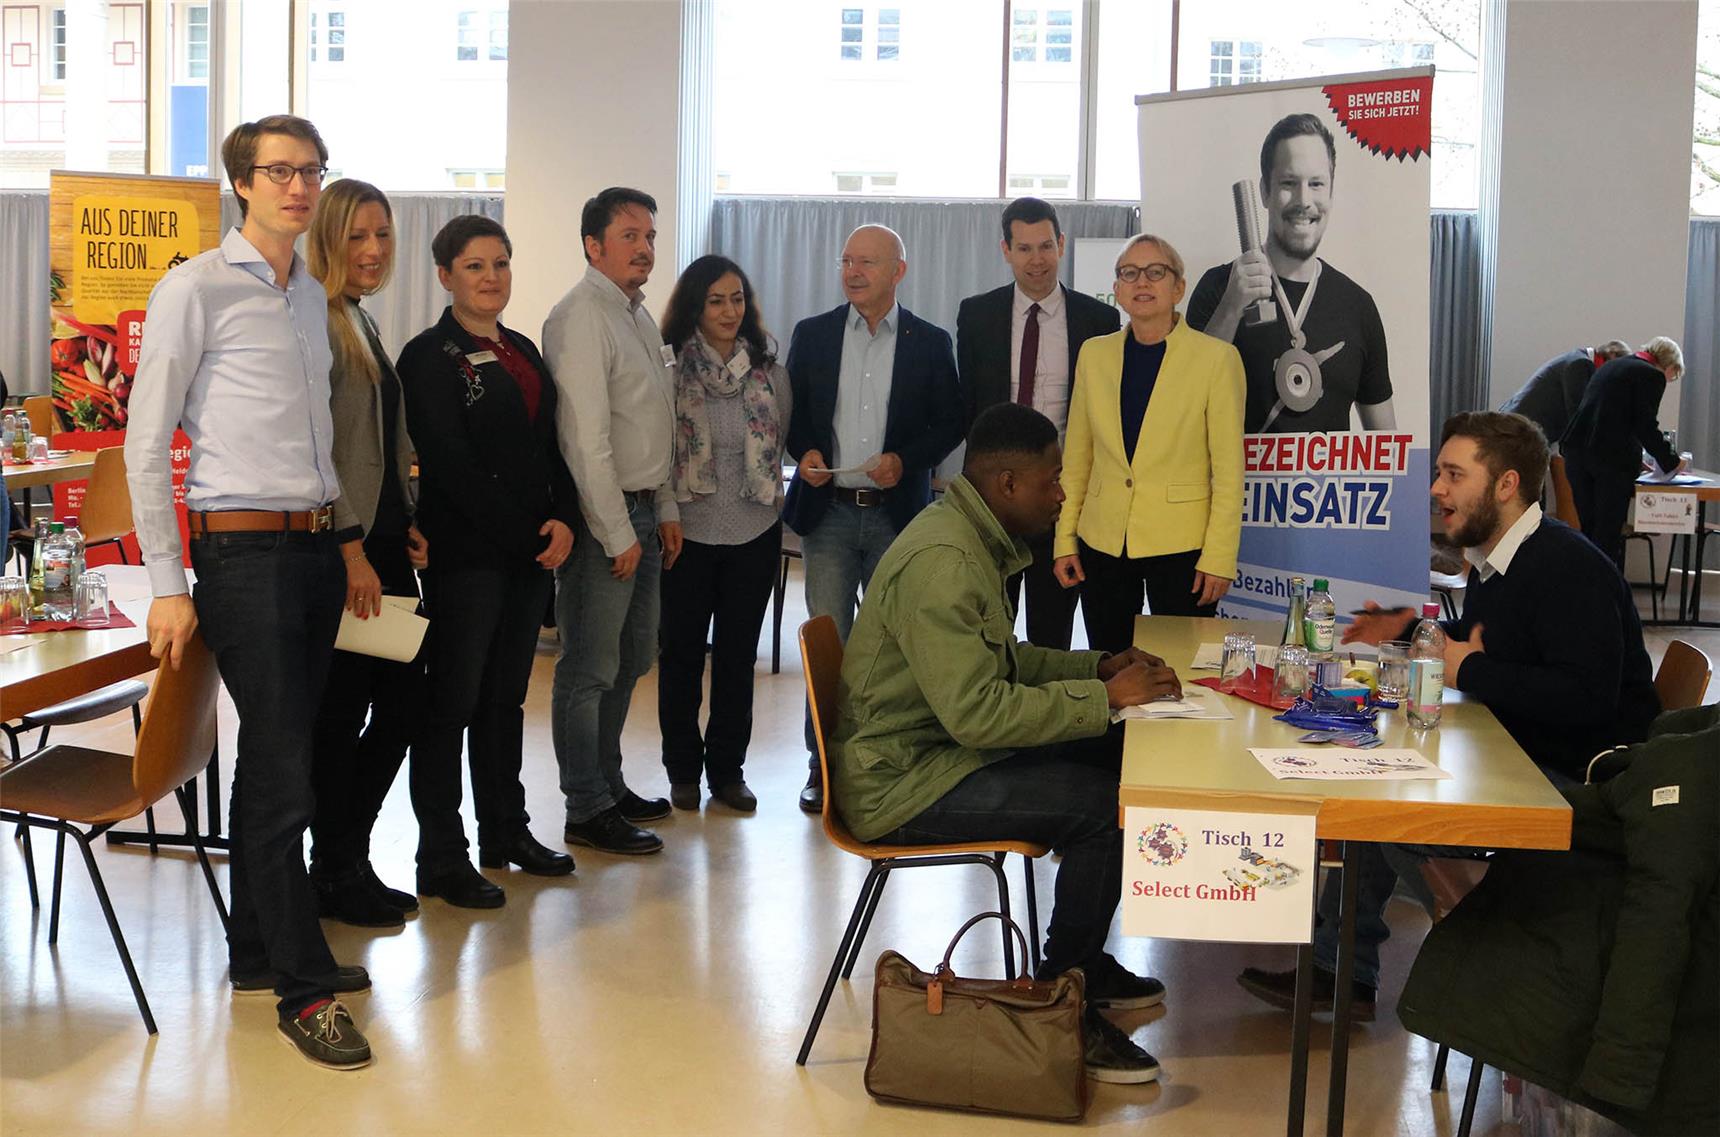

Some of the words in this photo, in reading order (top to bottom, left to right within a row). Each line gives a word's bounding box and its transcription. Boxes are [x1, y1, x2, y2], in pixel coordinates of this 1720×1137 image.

[1347, 88, 1420, 108] BEWERBEN
[1348, 109, 1362, 120] SIE
[1364, 107, 1386, 119] SICH
[1387, 105, 1419, 117] JETZT!
[81, 207, 112, 236] AUS
[119, 209, 178, 238] DEINER
[87, 241, 147, 270] REGION
[1243, 434, 1413, 472] EZEICHNET
[1202, 829, 1251, 847] Tisch
[1262, 832, 1284, 848] 12
[1132, 880, 1191, 899] Select
[1195, 883, 1257, 902] GmbH
